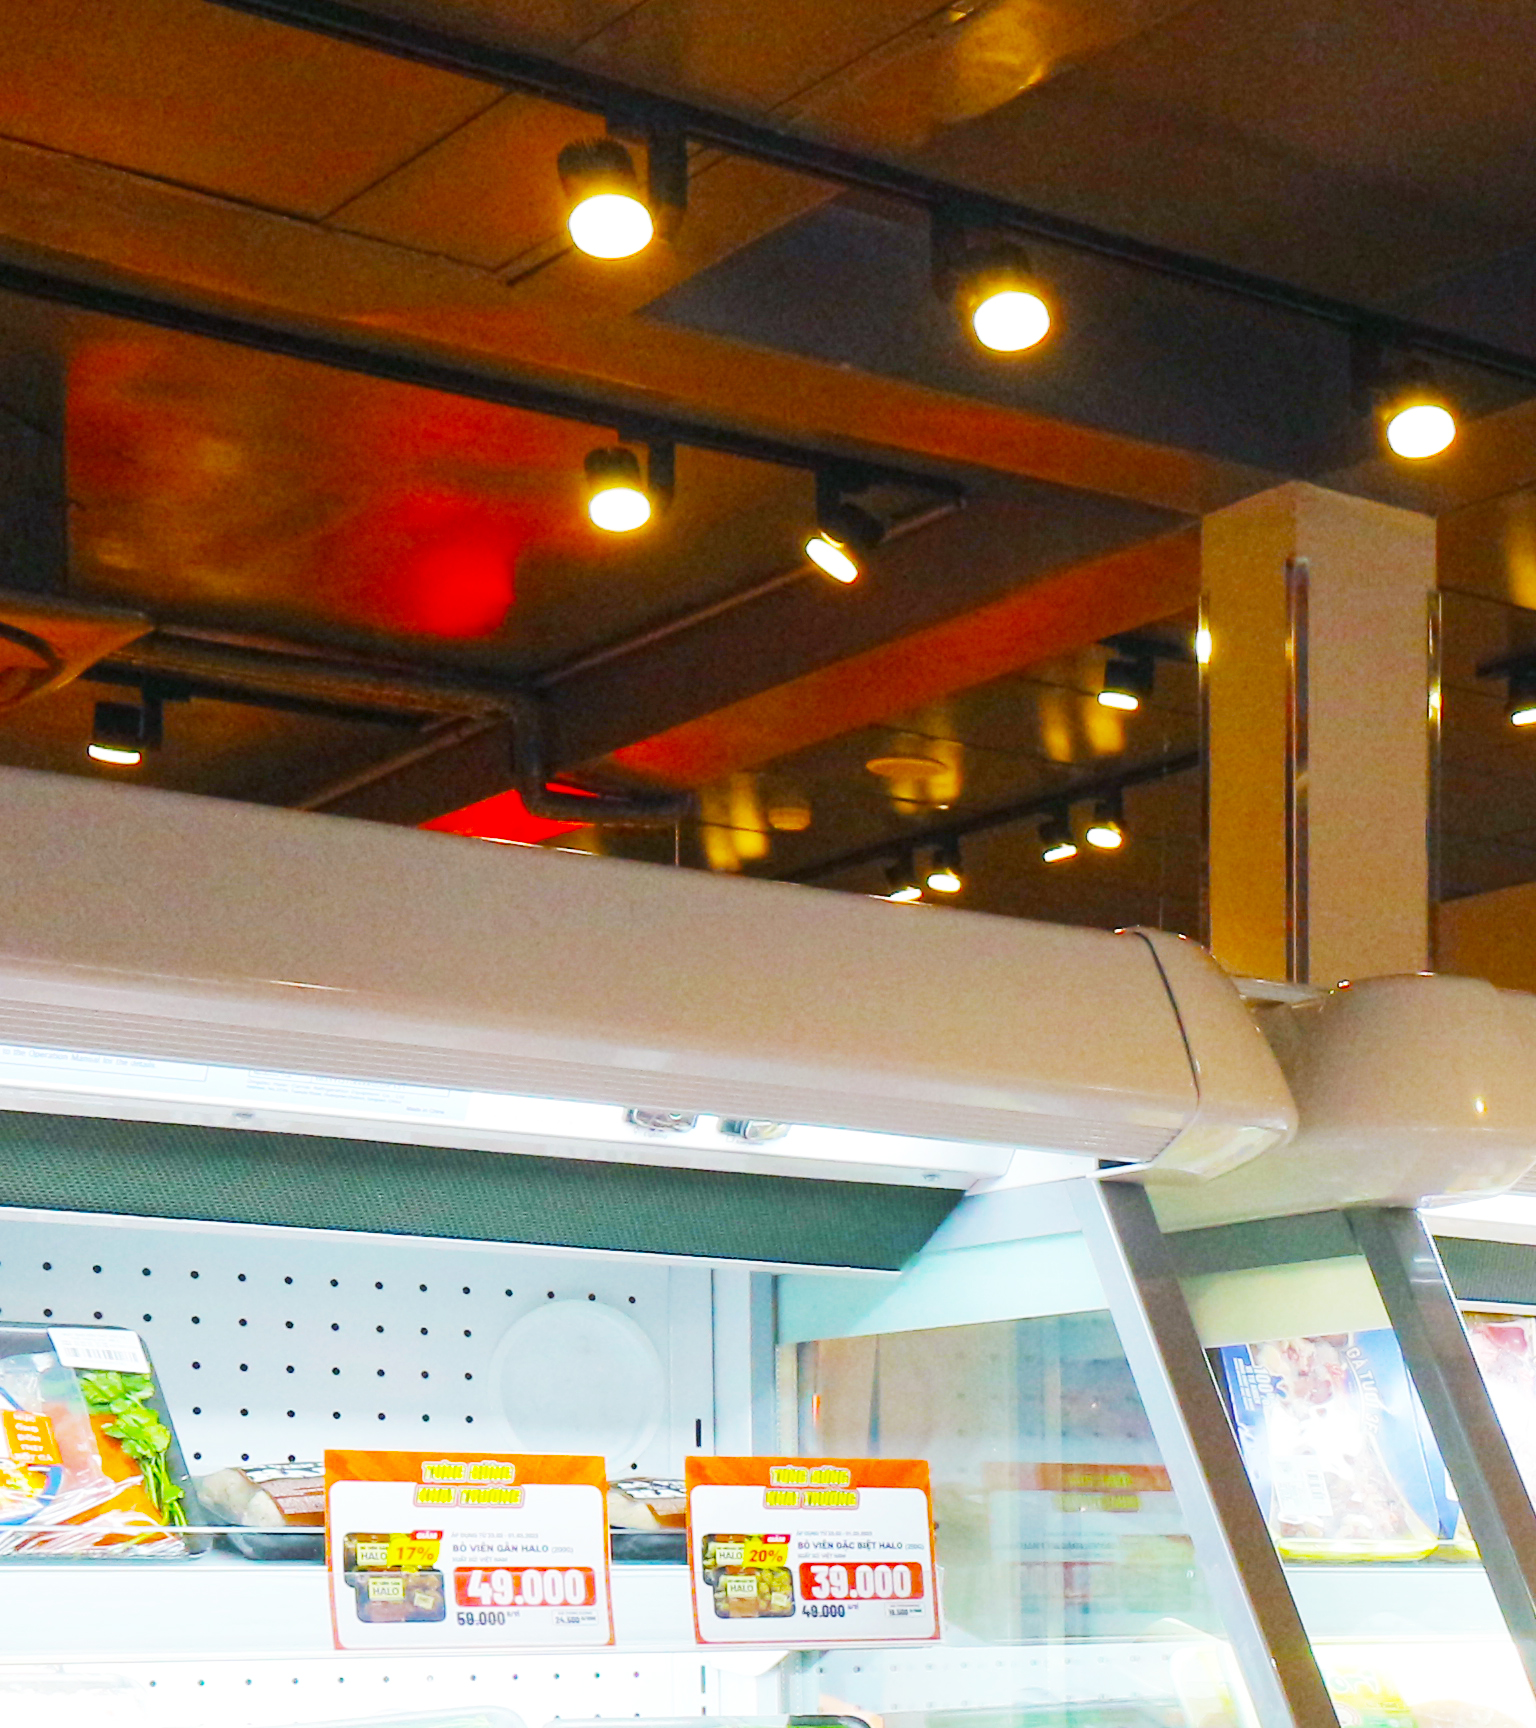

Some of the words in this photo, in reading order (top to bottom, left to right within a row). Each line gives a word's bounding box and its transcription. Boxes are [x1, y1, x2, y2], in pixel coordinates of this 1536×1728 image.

[470, 1542, 494, 1553] VIÊN
[522, 1543, 549, 1553] HALO
[814, 1540, 834, 1550] VIÊN
[879, 1541, 903, 1550] HALO
[361, 1551, 387, 1561] HALO
[397, 1546, 434, 1561] 17%
[719, 1551, 743, 1560] HALO
[750, 1549, 783, 1562] 20%
[468, 1568, 586, 1606] 49.000
[810, 1564, 912, 1600] 39.000
[372, 1585, 401, 1597] HALO
[729, 1583, 755, 1594] HALO
